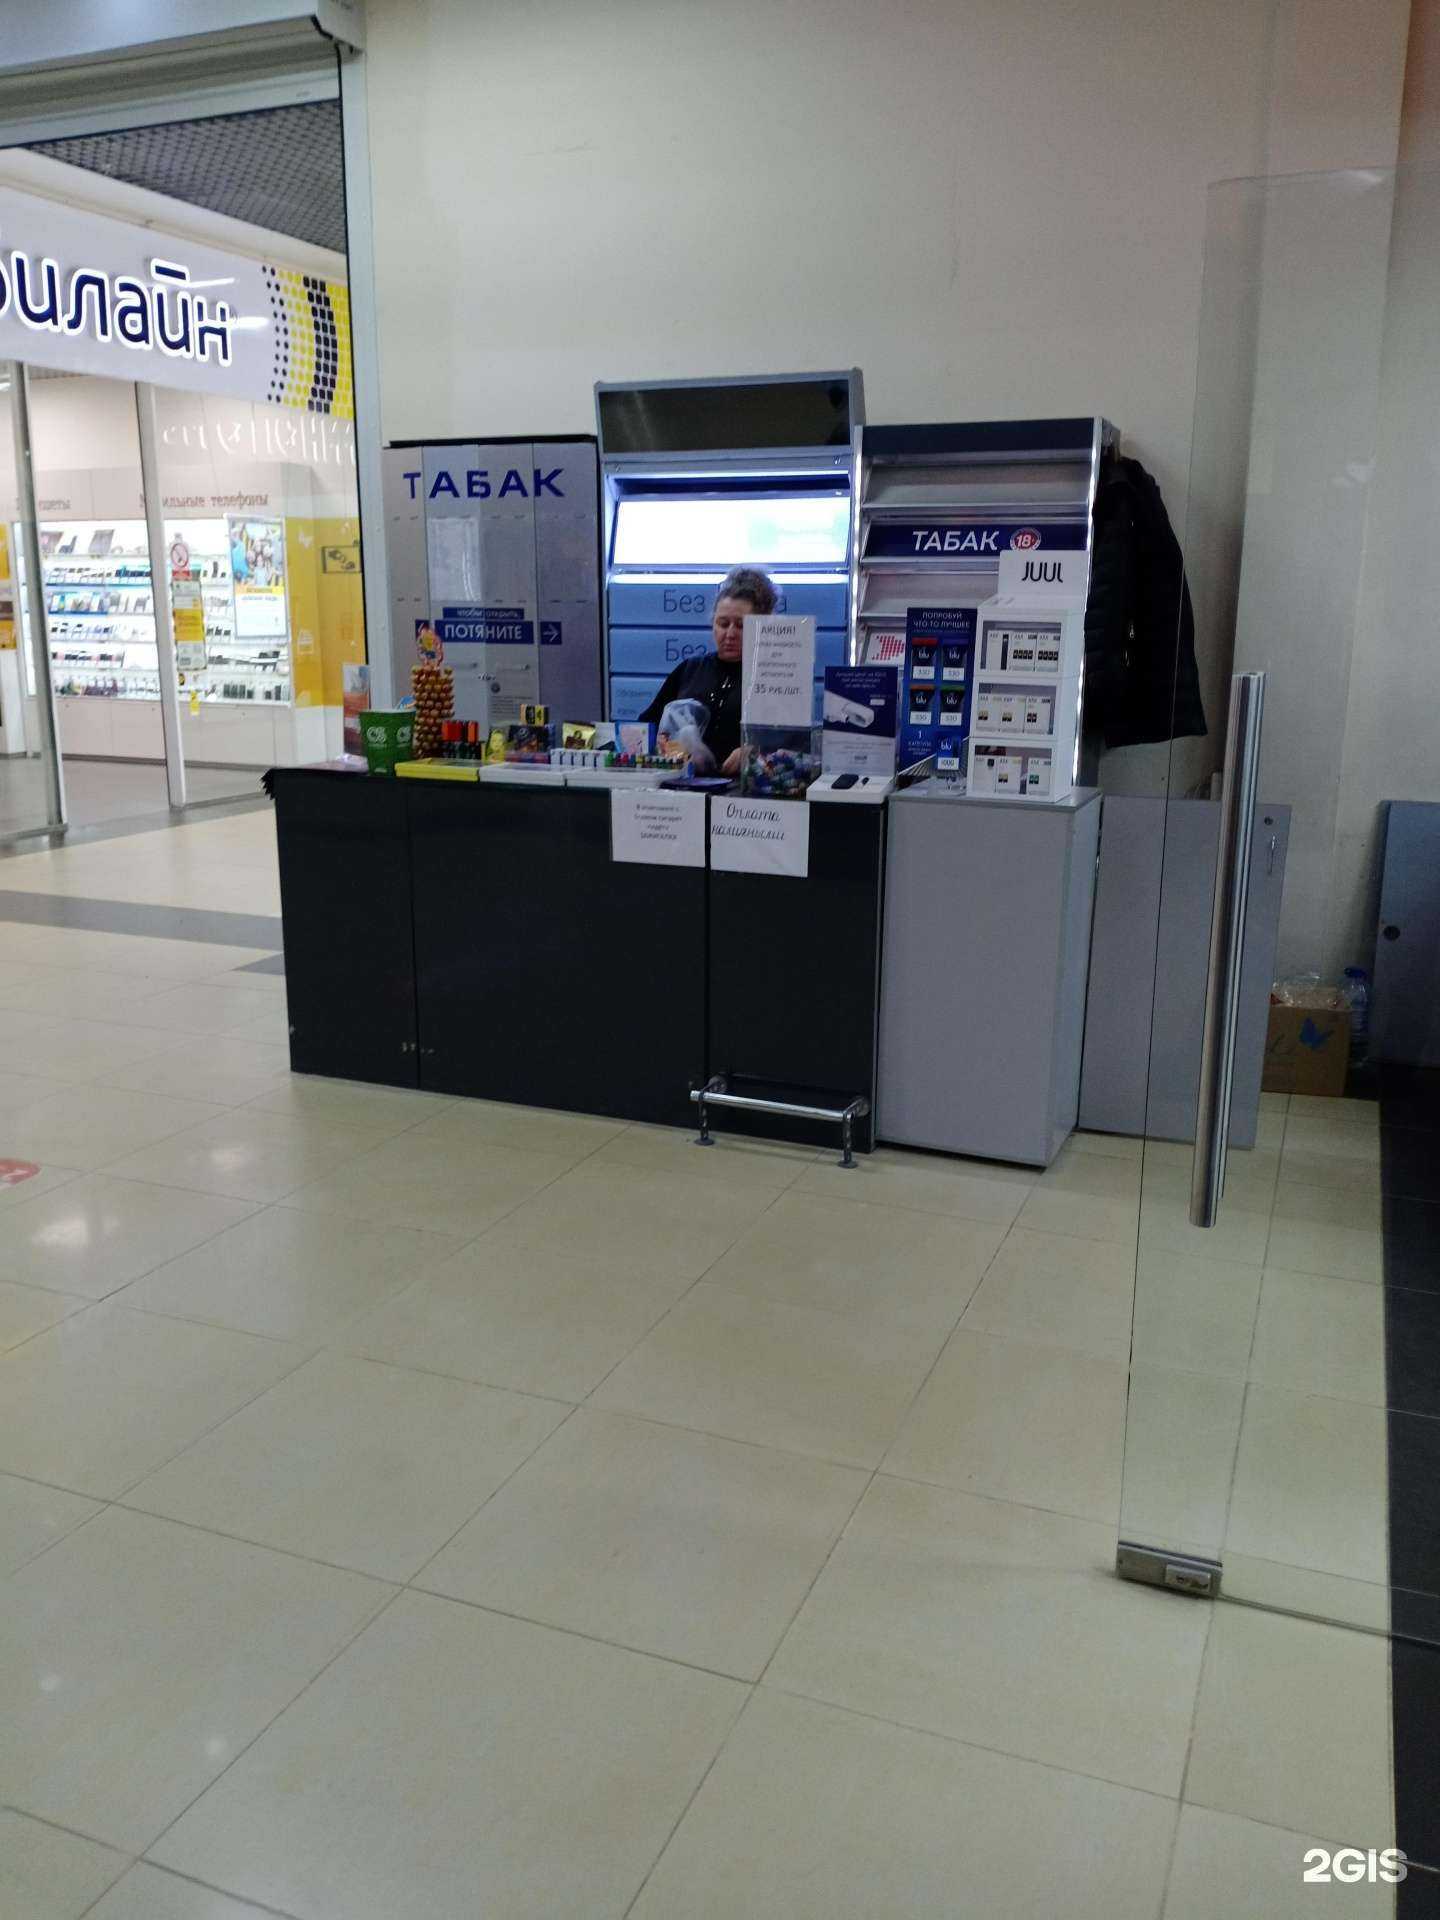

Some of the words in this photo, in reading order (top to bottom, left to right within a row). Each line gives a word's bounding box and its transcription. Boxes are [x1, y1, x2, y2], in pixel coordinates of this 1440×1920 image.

[0, 250, 234, 366] илайн
[403, 468, 565, 499] ТАБАК
[912, 529, 999, 551] ТАБАК
[1021, 561, 1063, 583] JUUL
[663, 589, 706, 614] Без
[444, 623, 523, 641] ПОТЯНИТЕ
[754, 684, 767, 694] 35
[726, 802, 782, 822] Оплата
